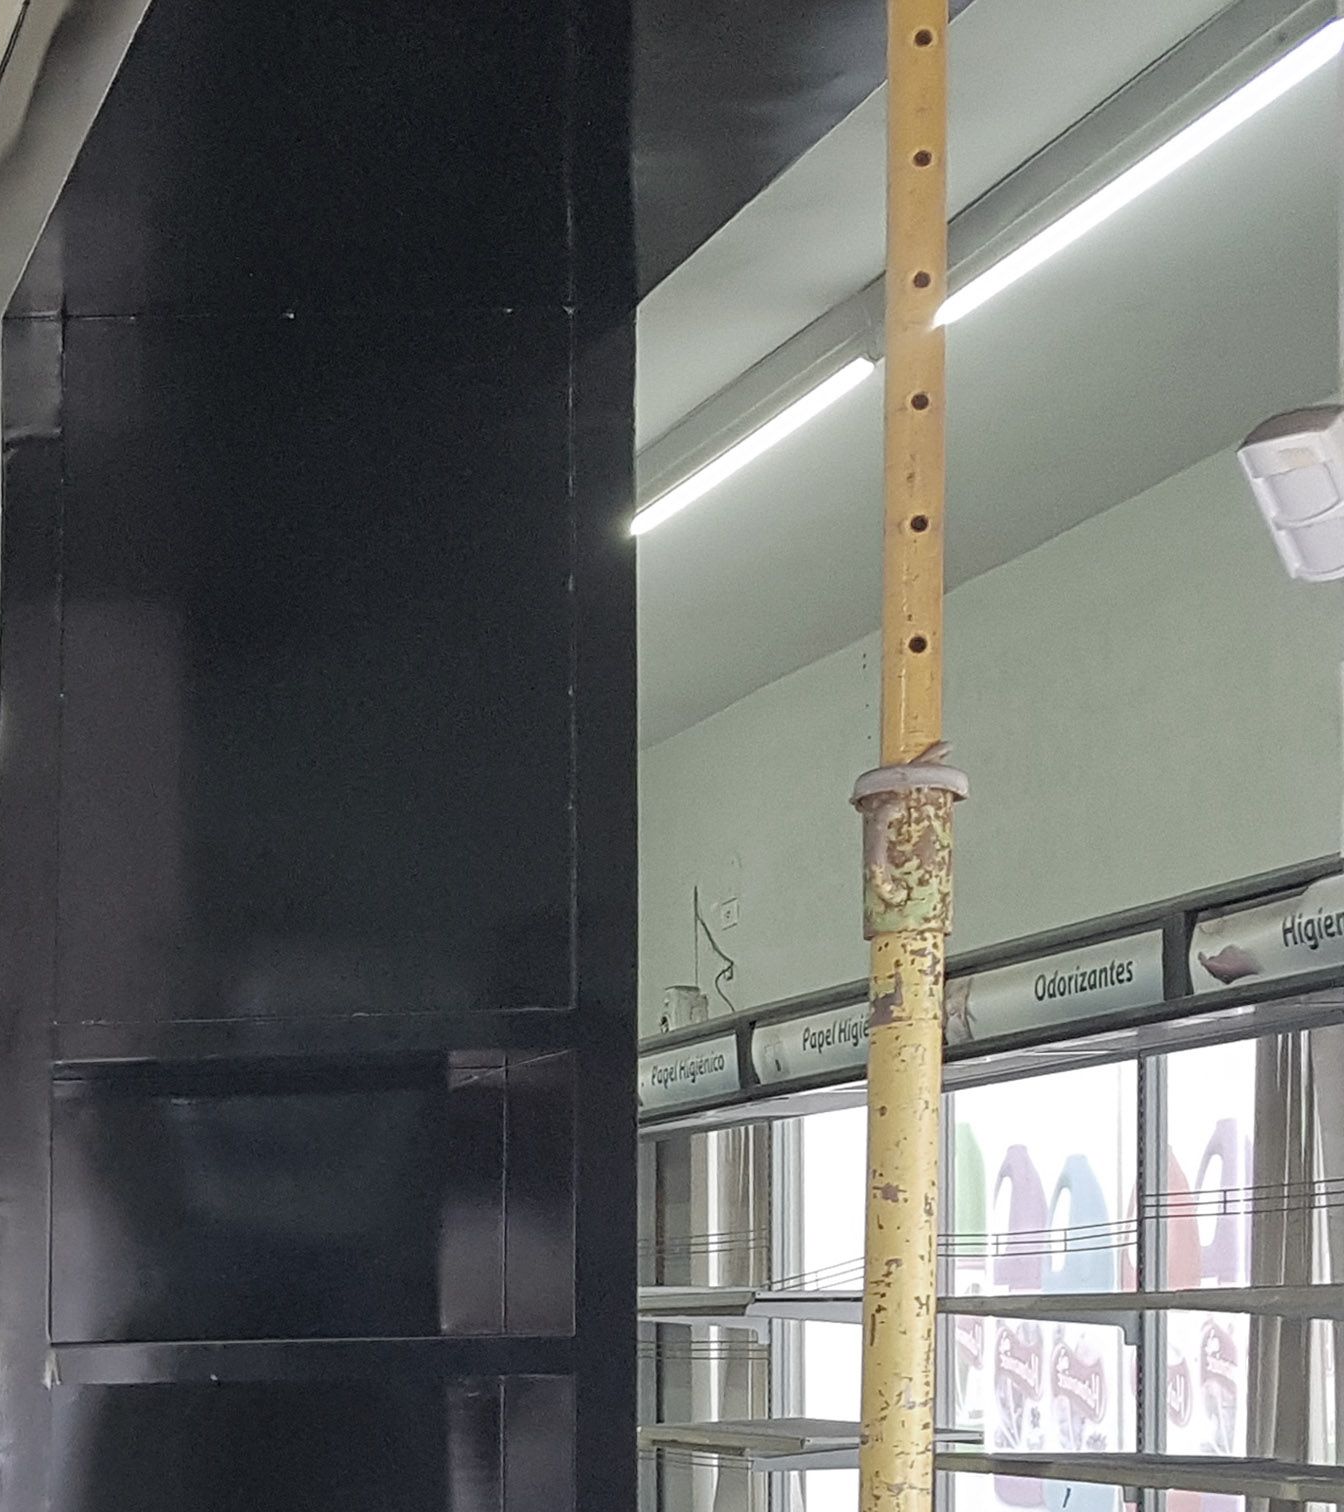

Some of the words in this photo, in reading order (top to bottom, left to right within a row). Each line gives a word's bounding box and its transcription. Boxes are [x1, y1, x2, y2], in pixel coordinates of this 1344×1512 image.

[1034, 958, 1134, 1001] Odorizantes
[803, 1023, 835, 1053] Papel
[838, 1012, 870, 1047] Higiê
[651, 1059, 678, 1089] Papel
